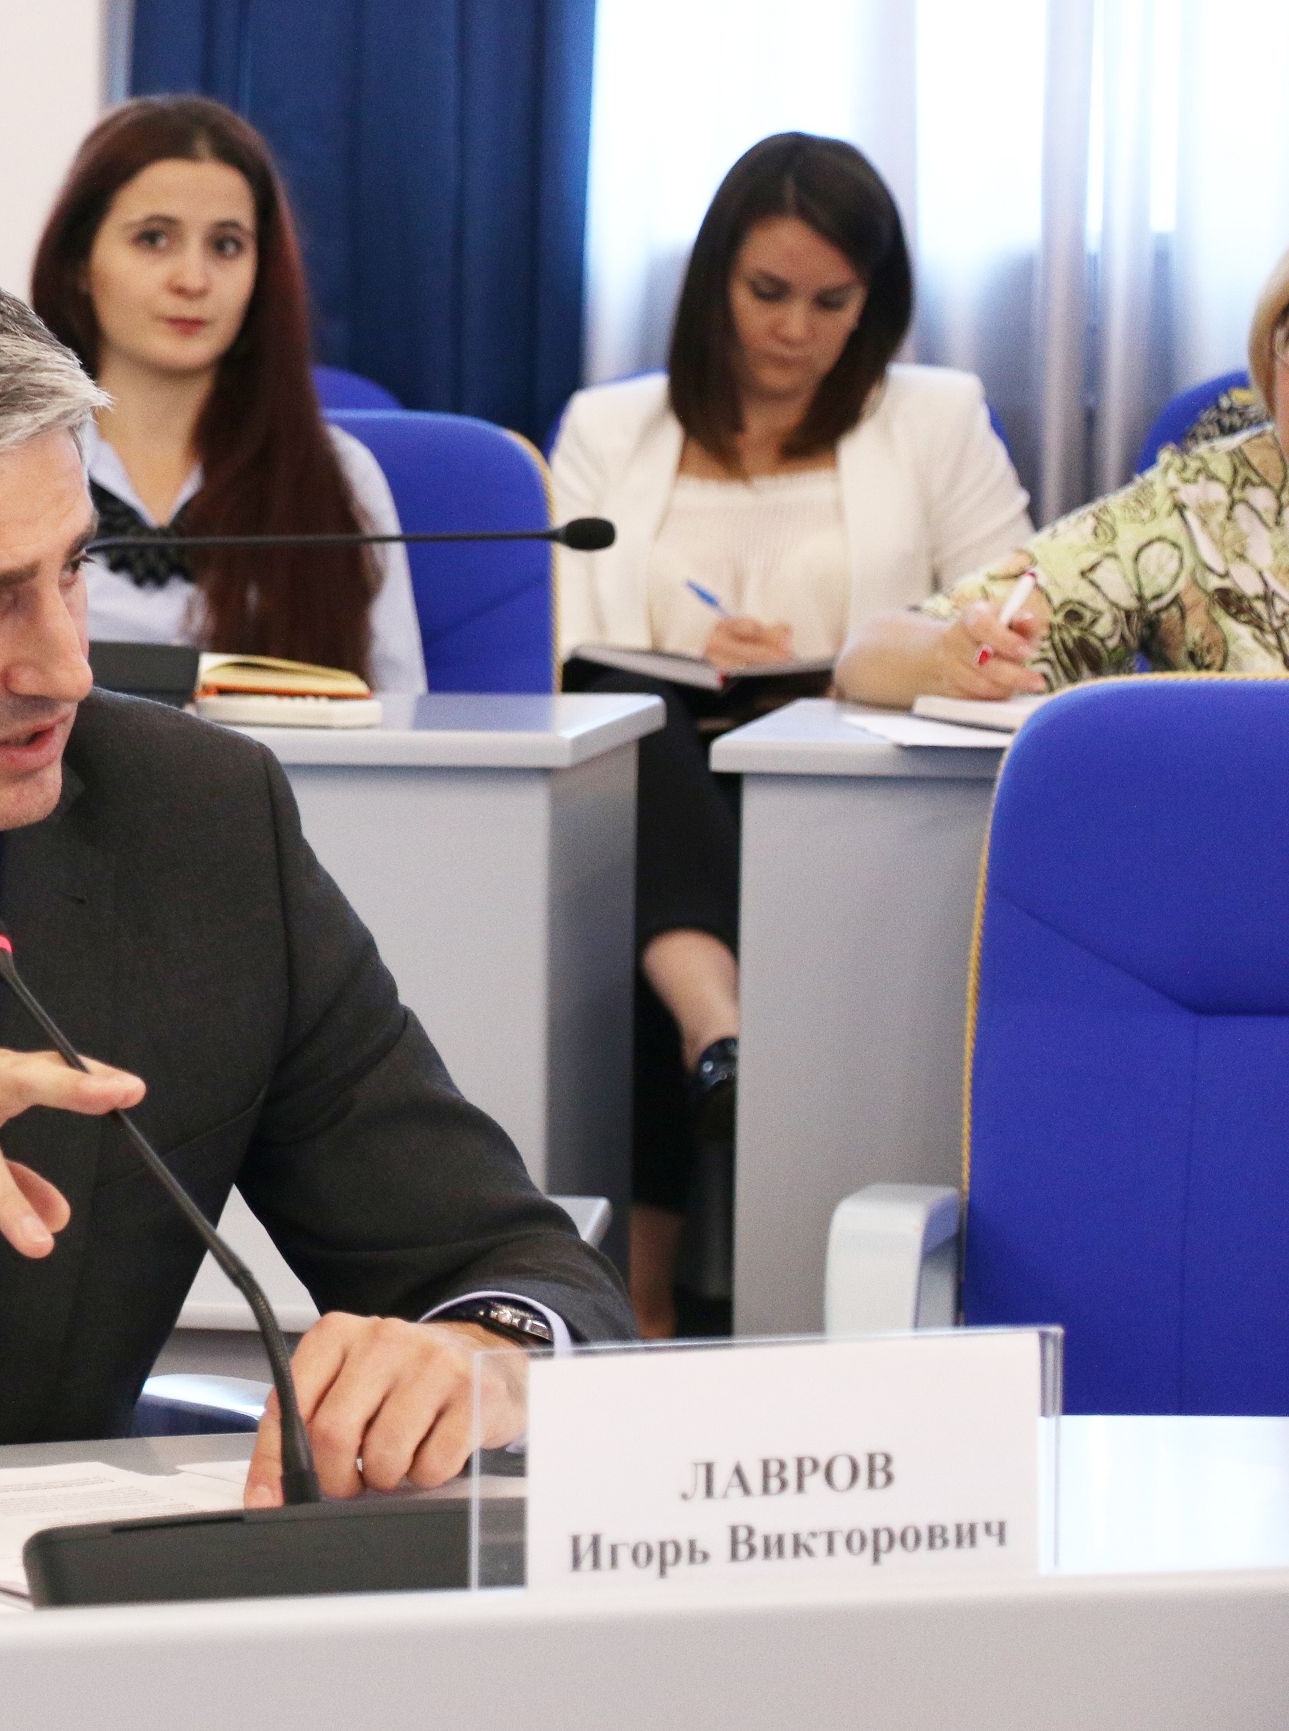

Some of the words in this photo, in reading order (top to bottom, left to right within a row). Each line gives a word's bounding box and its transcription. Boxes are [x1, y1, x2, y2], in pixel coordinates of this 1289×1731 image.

[680, 1450, 895, 1501] ЛАВРОВ
[569, 1532, 710, 1578] Игорь
[728, 1519, 1007, 1566] Викторович
